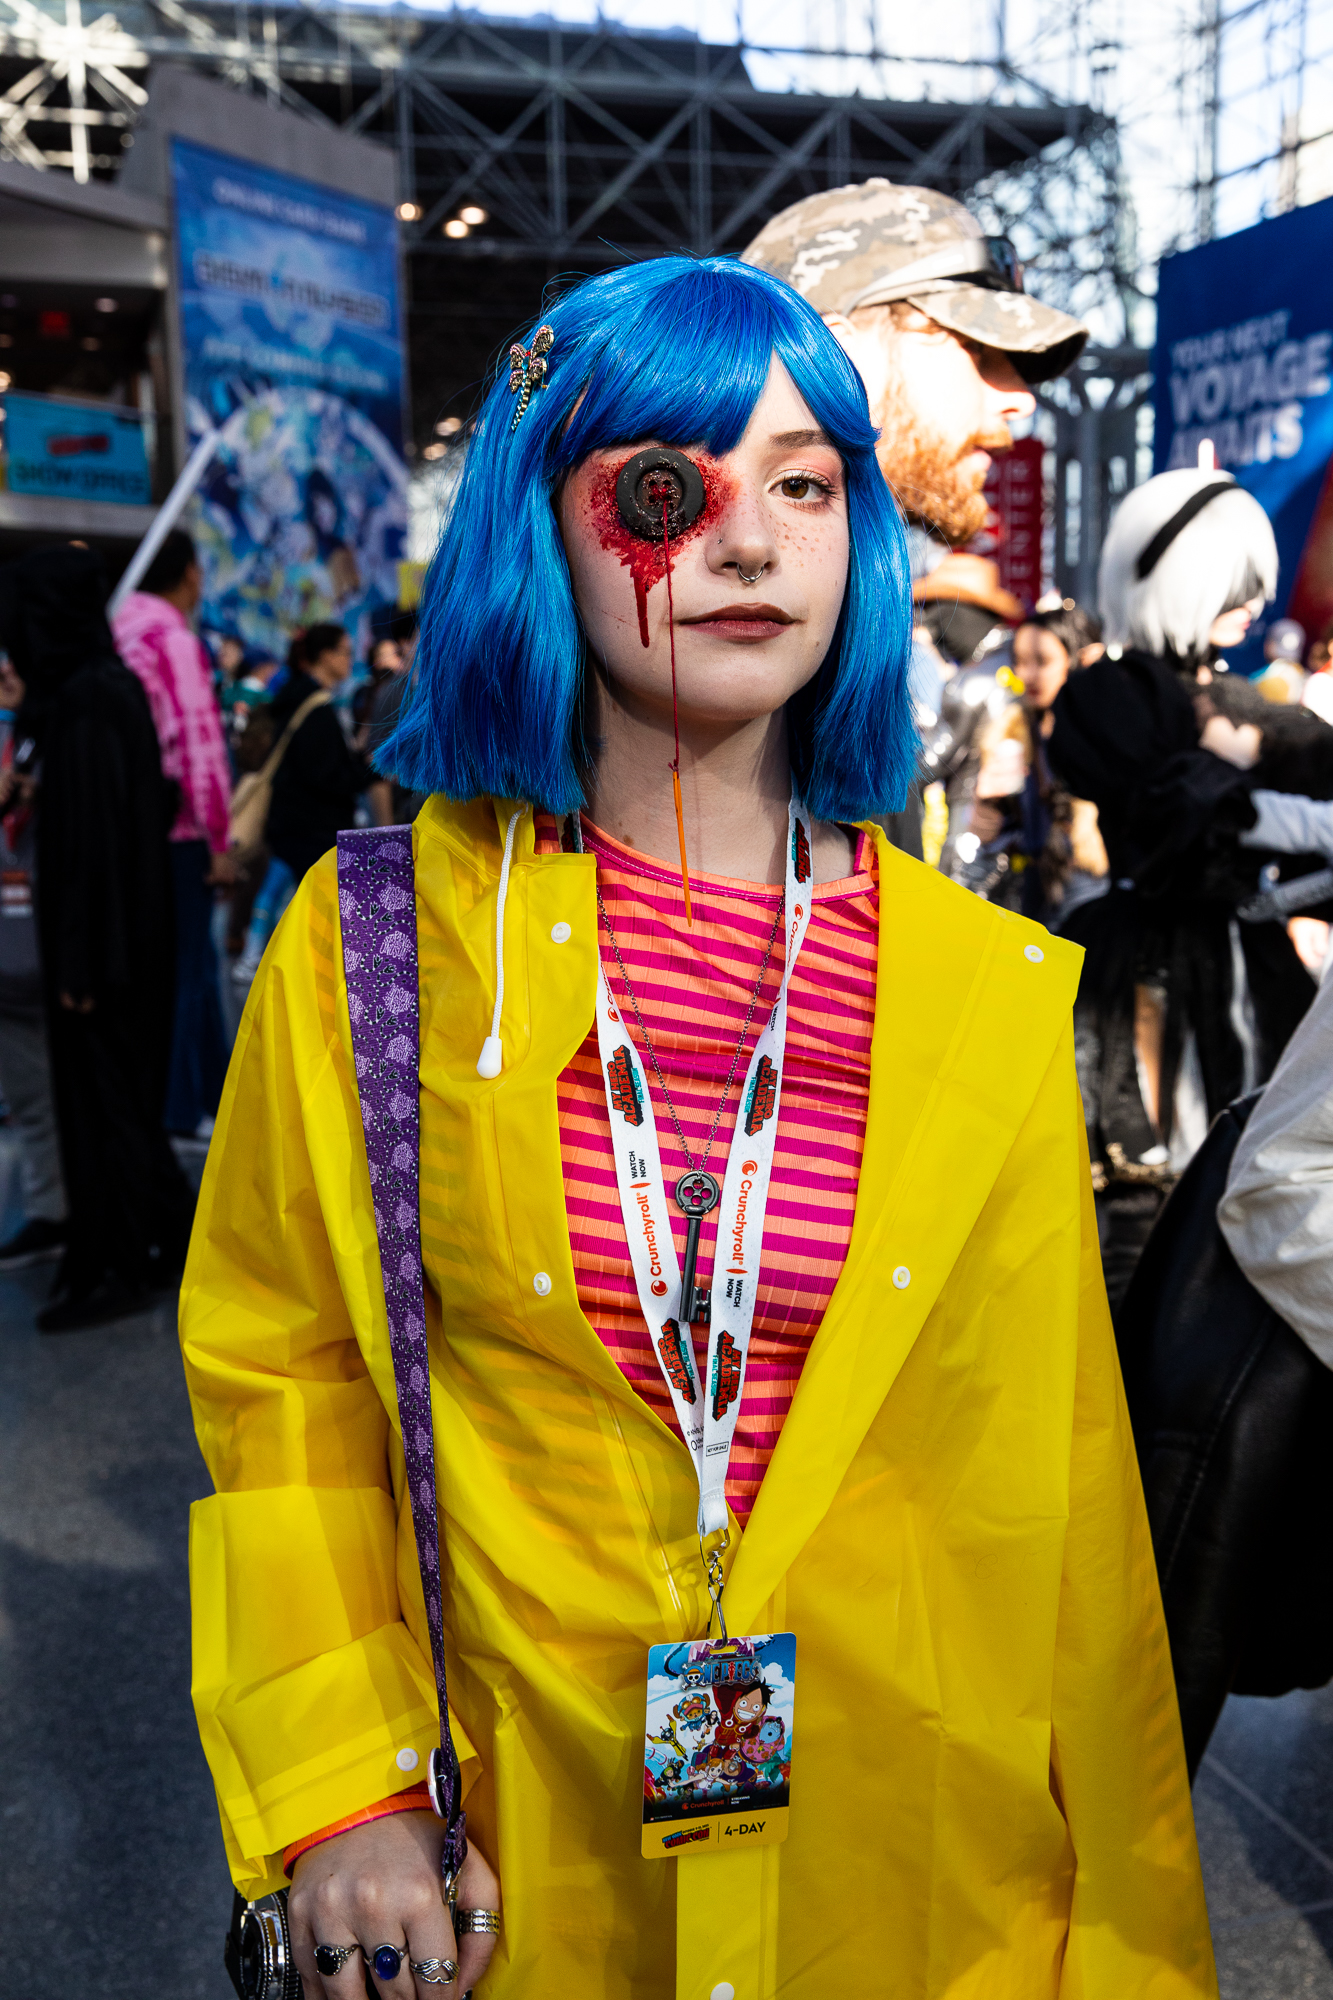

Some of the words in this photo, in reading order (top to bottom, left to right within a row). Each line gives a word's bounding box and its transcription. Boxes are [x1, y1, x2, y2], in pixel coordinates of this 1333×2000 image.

[1169, 331, 1333, 424] VOYAGE
[607, 1061, 620, 1091] HERO
[612, 1045, 642, 1126] ACADEMIA
[768, 1069, 778, 1089] MY
[611, 1091, 624, 1111] MY
[748, 1055, 772, 1136] ACADEMIA
[763, 1089, 776, 1120] HERO
[629, 1151, 638, 1179] WATCH
[726, 1278, 734, 1299] NOW
[733, 1279, 743, 1308] WATCH
[658, 1338, 673, 1370] HERO
[660, 1318, 694, 1405] ACADEMIA
[732, 1348, 742, 1369] MY
[668, 1371, 682, 1389] MY
[716, 1330, 734, 1421] ACADEMIA
[728, 1370, 741, 1403] HERO
[684, 1663, 722, 1688] ONE
[721, 1659, 760, 1684] PIECE
[690, 1800, 725, 1809] Crunchyroll
[664, 1832, 691, 1849] COMIC
[692, 1827, 710, 1841] CON
[724, 1821, 767, 1837] 4-DAY
